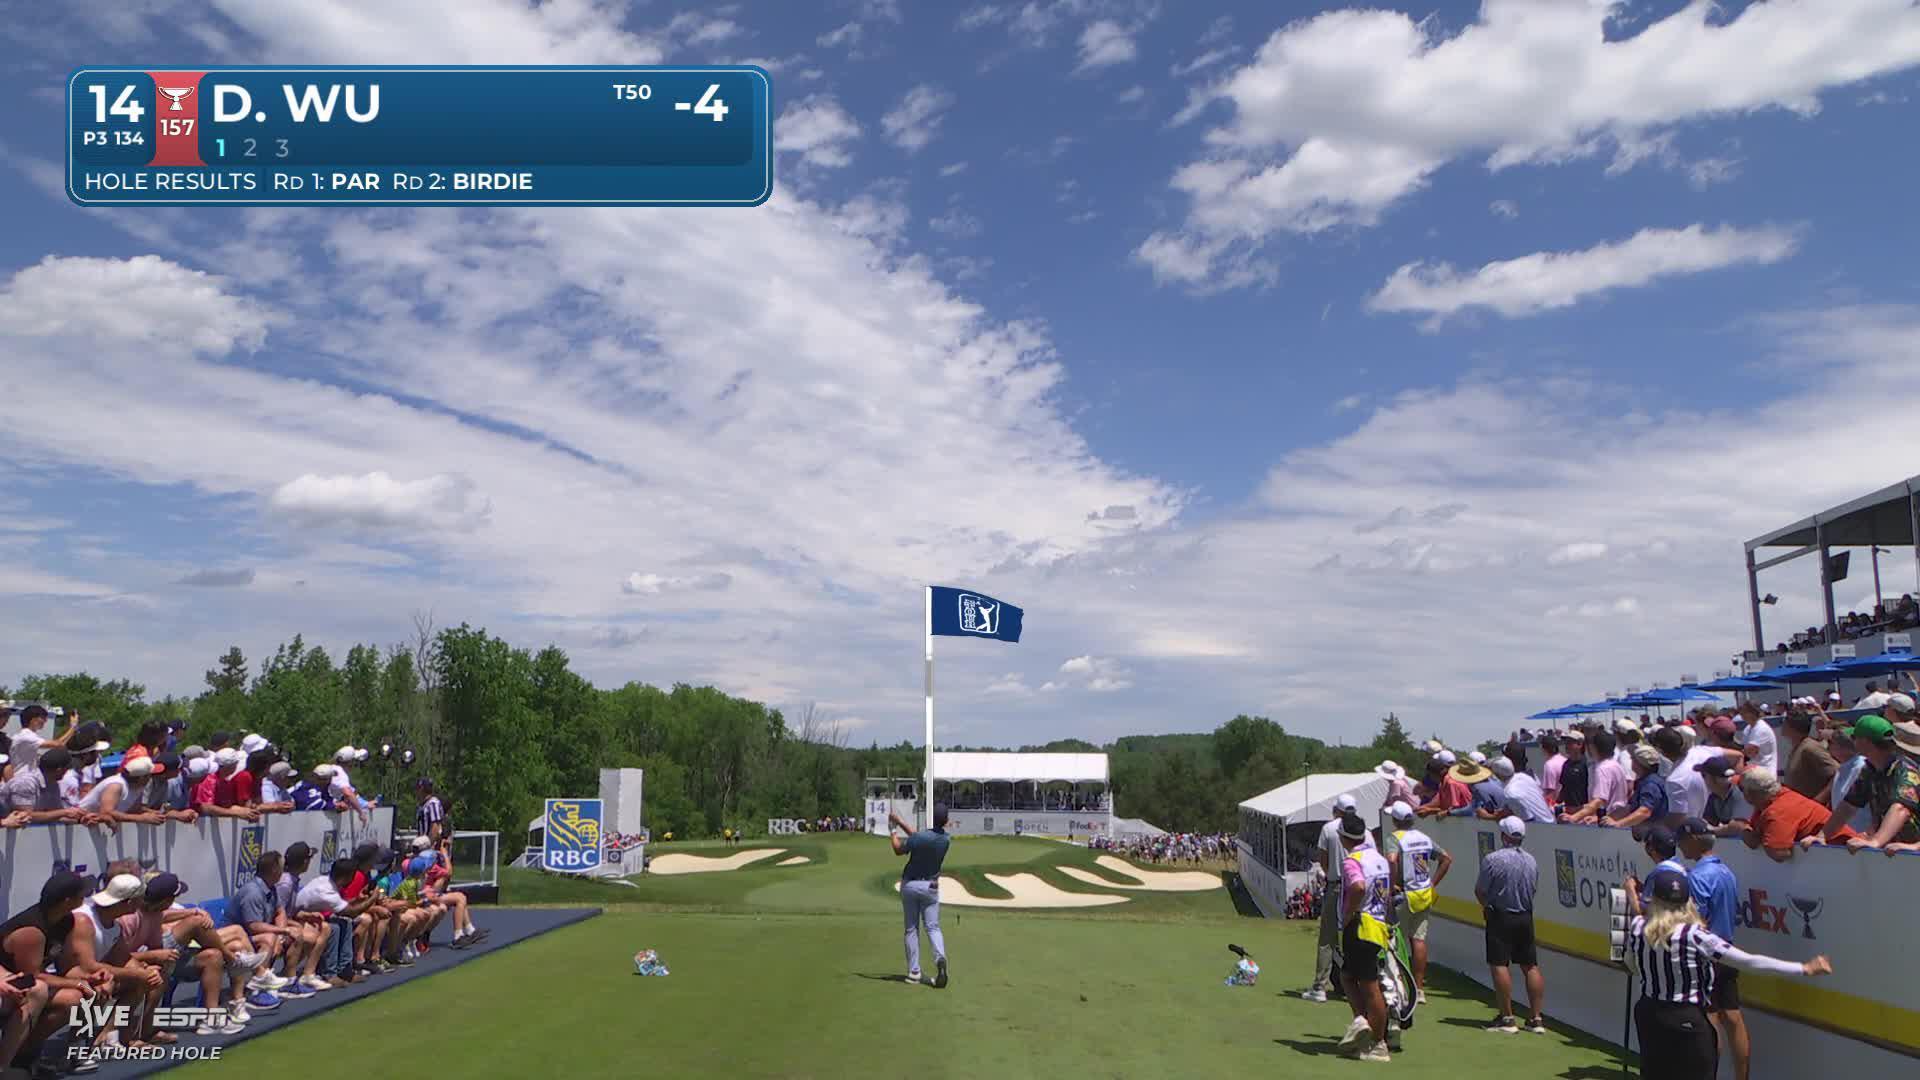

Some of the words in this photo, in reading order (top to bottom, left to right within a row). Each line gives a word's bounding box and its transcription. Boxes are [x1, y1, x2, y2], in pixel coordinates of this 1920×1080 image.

[768, 819, 807, 835] RBC
[550, 849, 597, 866] RBC
[1578, 851, 1638, 876] CANADIAN
